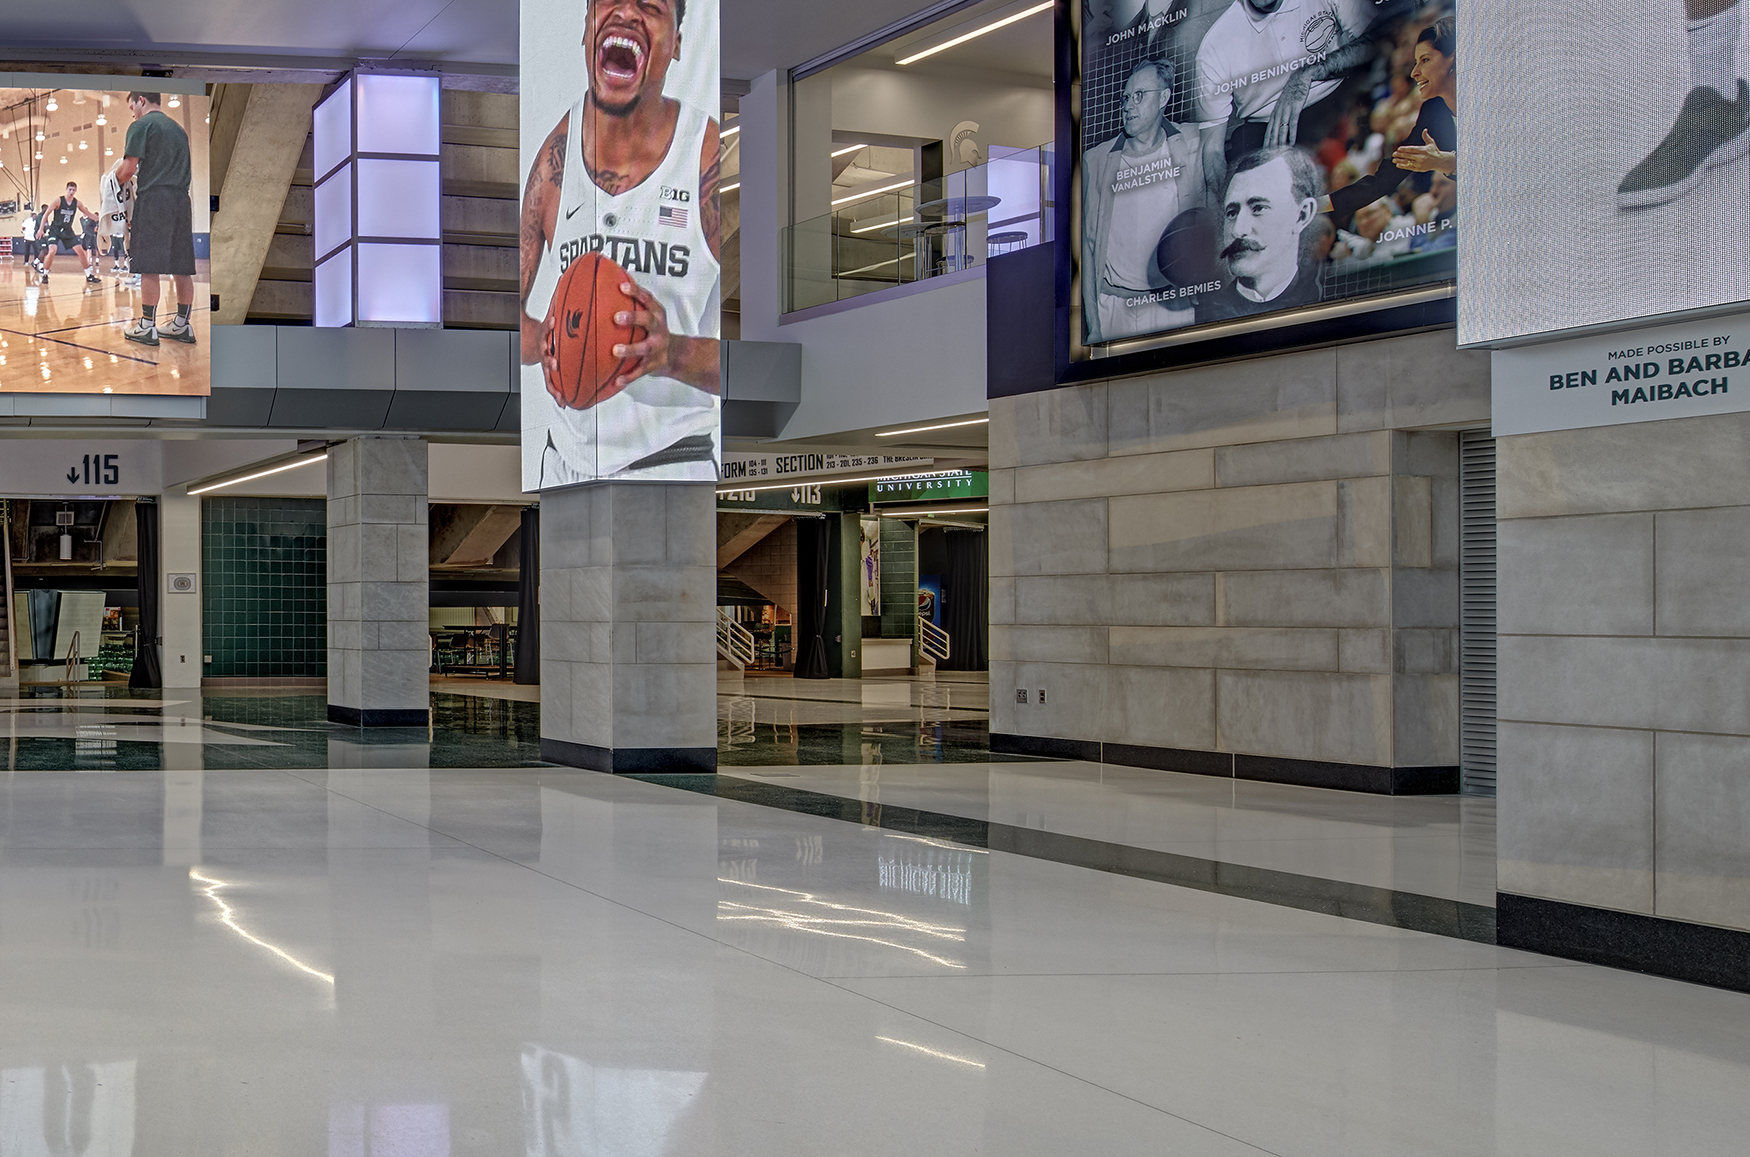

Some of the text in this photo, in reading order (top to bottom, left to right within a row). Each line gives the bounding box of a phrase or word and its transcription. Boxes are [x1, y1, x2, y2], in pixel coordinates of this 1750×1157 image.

[1106, 8, 1188, 46] JOHN MACKLIN
[1214, 51, 1327, 95] JOHN BENINGTON
[1116, 157, 1172, 181] BENJAMIN
[1376, 218, 1453, 244] JOANNE P.
[1126, 280, 1222, 308] CHARLES BEMIES
[1608, 335, 1731, 360] MADE POSSIBLE BY
[1550, 369, 1597, 390] BEN
[1605, 362, 1660, 383] AND
[1611, 377, 1728, 406] MAIBACH
[83, 454, 119, 484] 115
[721, 454, 824, 478] ORM SECTION
[826, 460, 836, 469] 213
[852, 458, 863, 466] 235
[877, 479, 972, 492] UNIVERSITY
